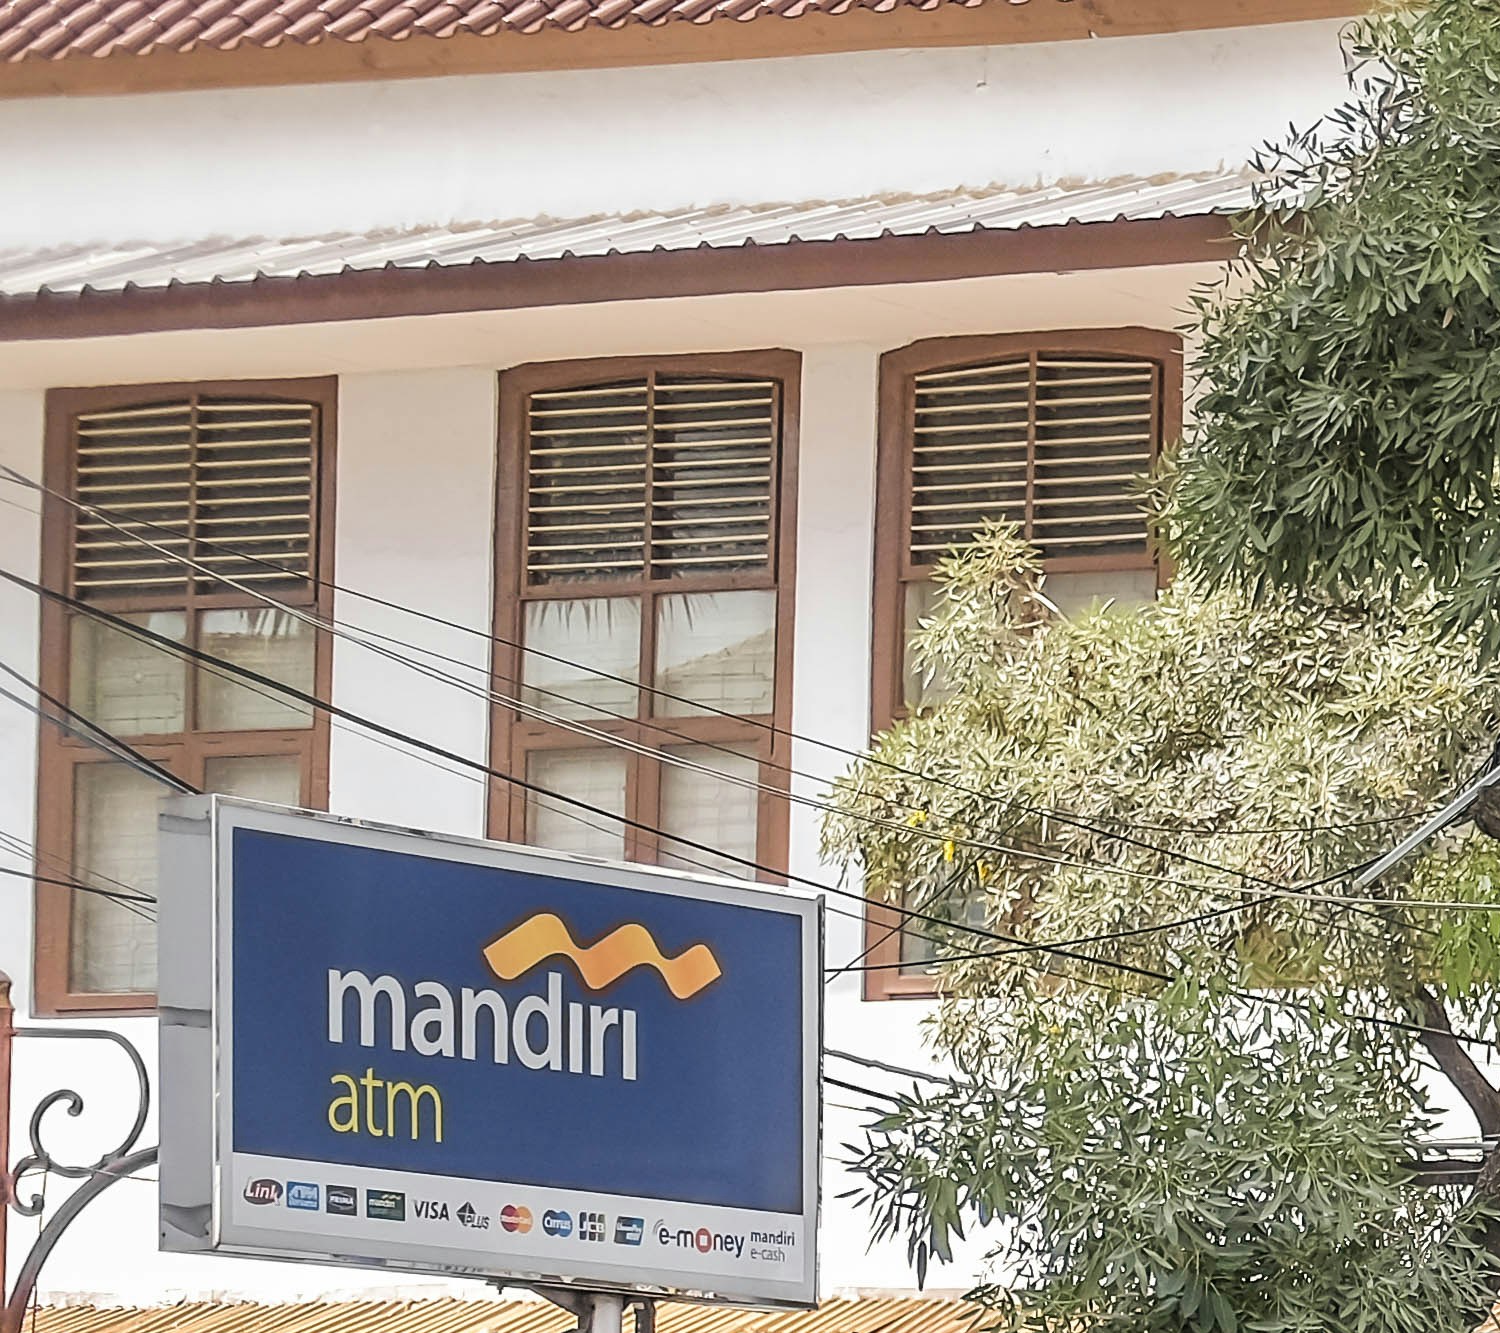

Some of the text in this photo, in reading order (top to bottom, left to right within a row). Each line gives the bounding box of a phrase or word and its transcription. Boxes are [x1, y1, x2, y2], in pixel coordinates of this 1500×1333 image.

[328, 967, 638, 1081] mandiri
[327, 1066, 443, 1144] atm
[247, 1177, 281, 1206] Link
[414, 1200, 450, 1221] VISA
[465, 1214, 490, 1230] PLUS
[659, 1227, 745, 1258] e-money
[750, 1230, 795, 1247] mandiri
[750, 1247, 785, 1262] e-cash
